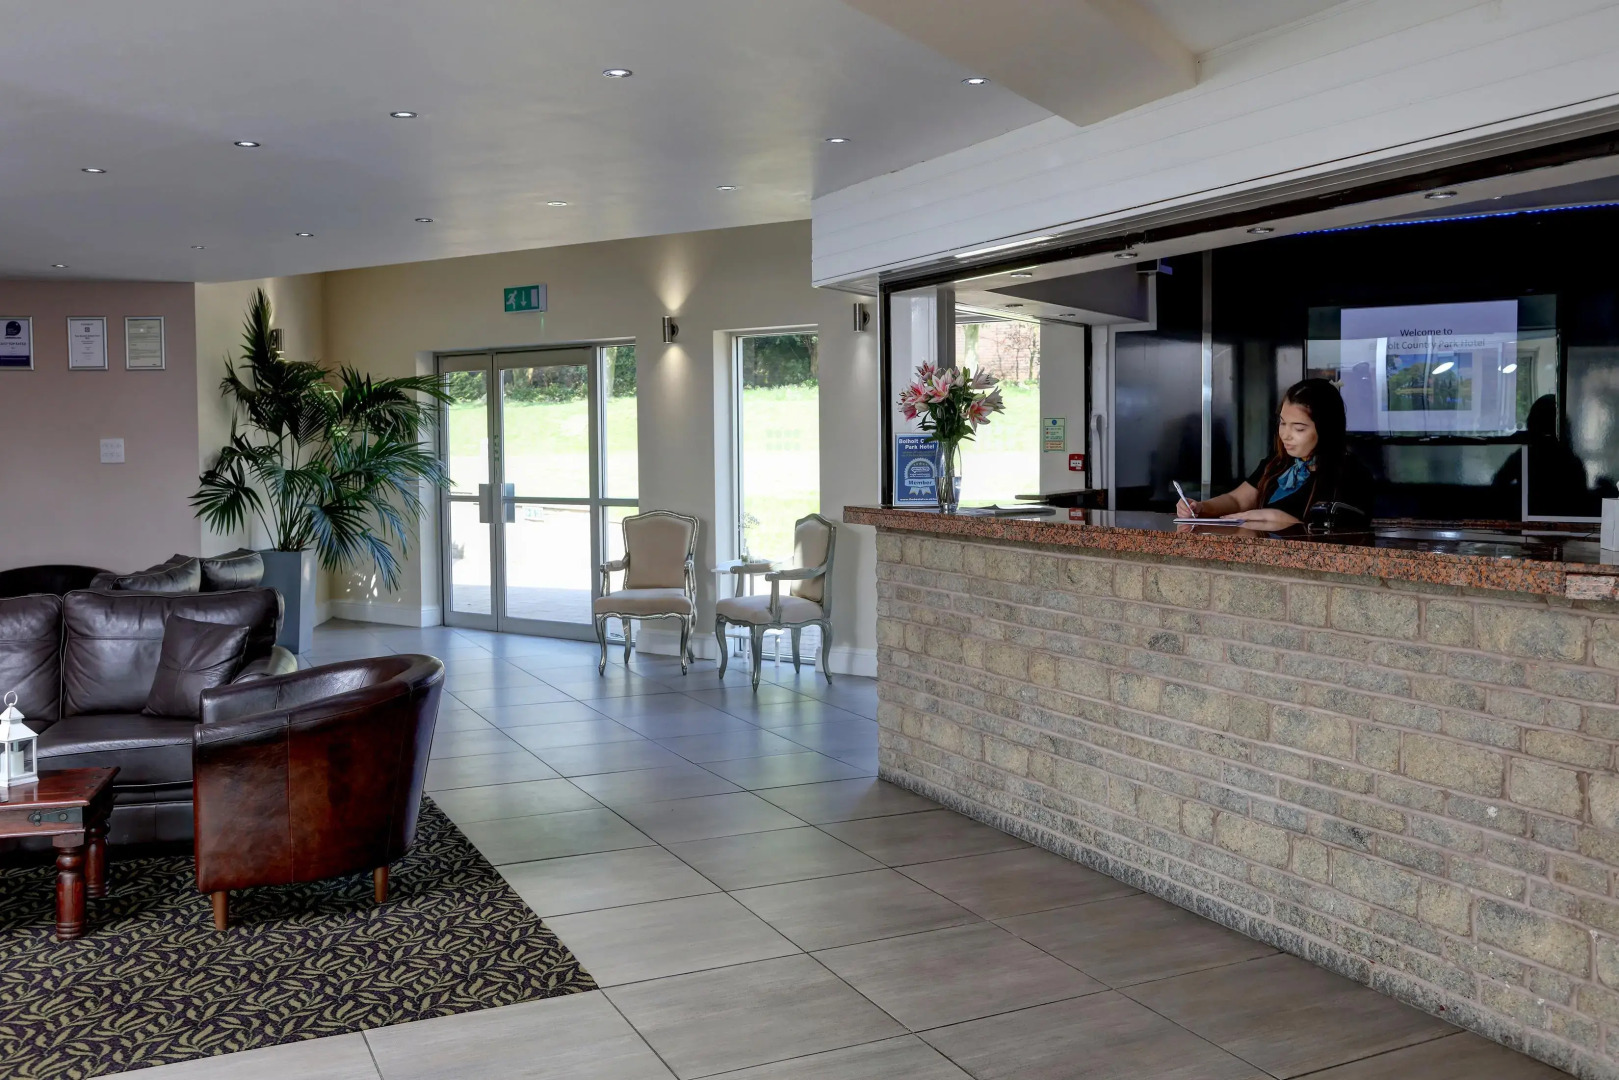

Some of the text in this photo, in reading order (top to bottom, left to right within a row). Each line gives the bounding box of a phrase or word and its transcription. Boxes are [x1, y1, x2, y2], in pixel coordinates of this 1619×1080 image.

[1400, 327, 1453, 338] Welcome to
[1401, 340, 1436, 351] County
[1438, 339, 1459, 349] Park
[1460, 337, 1485, 348] Hotel
